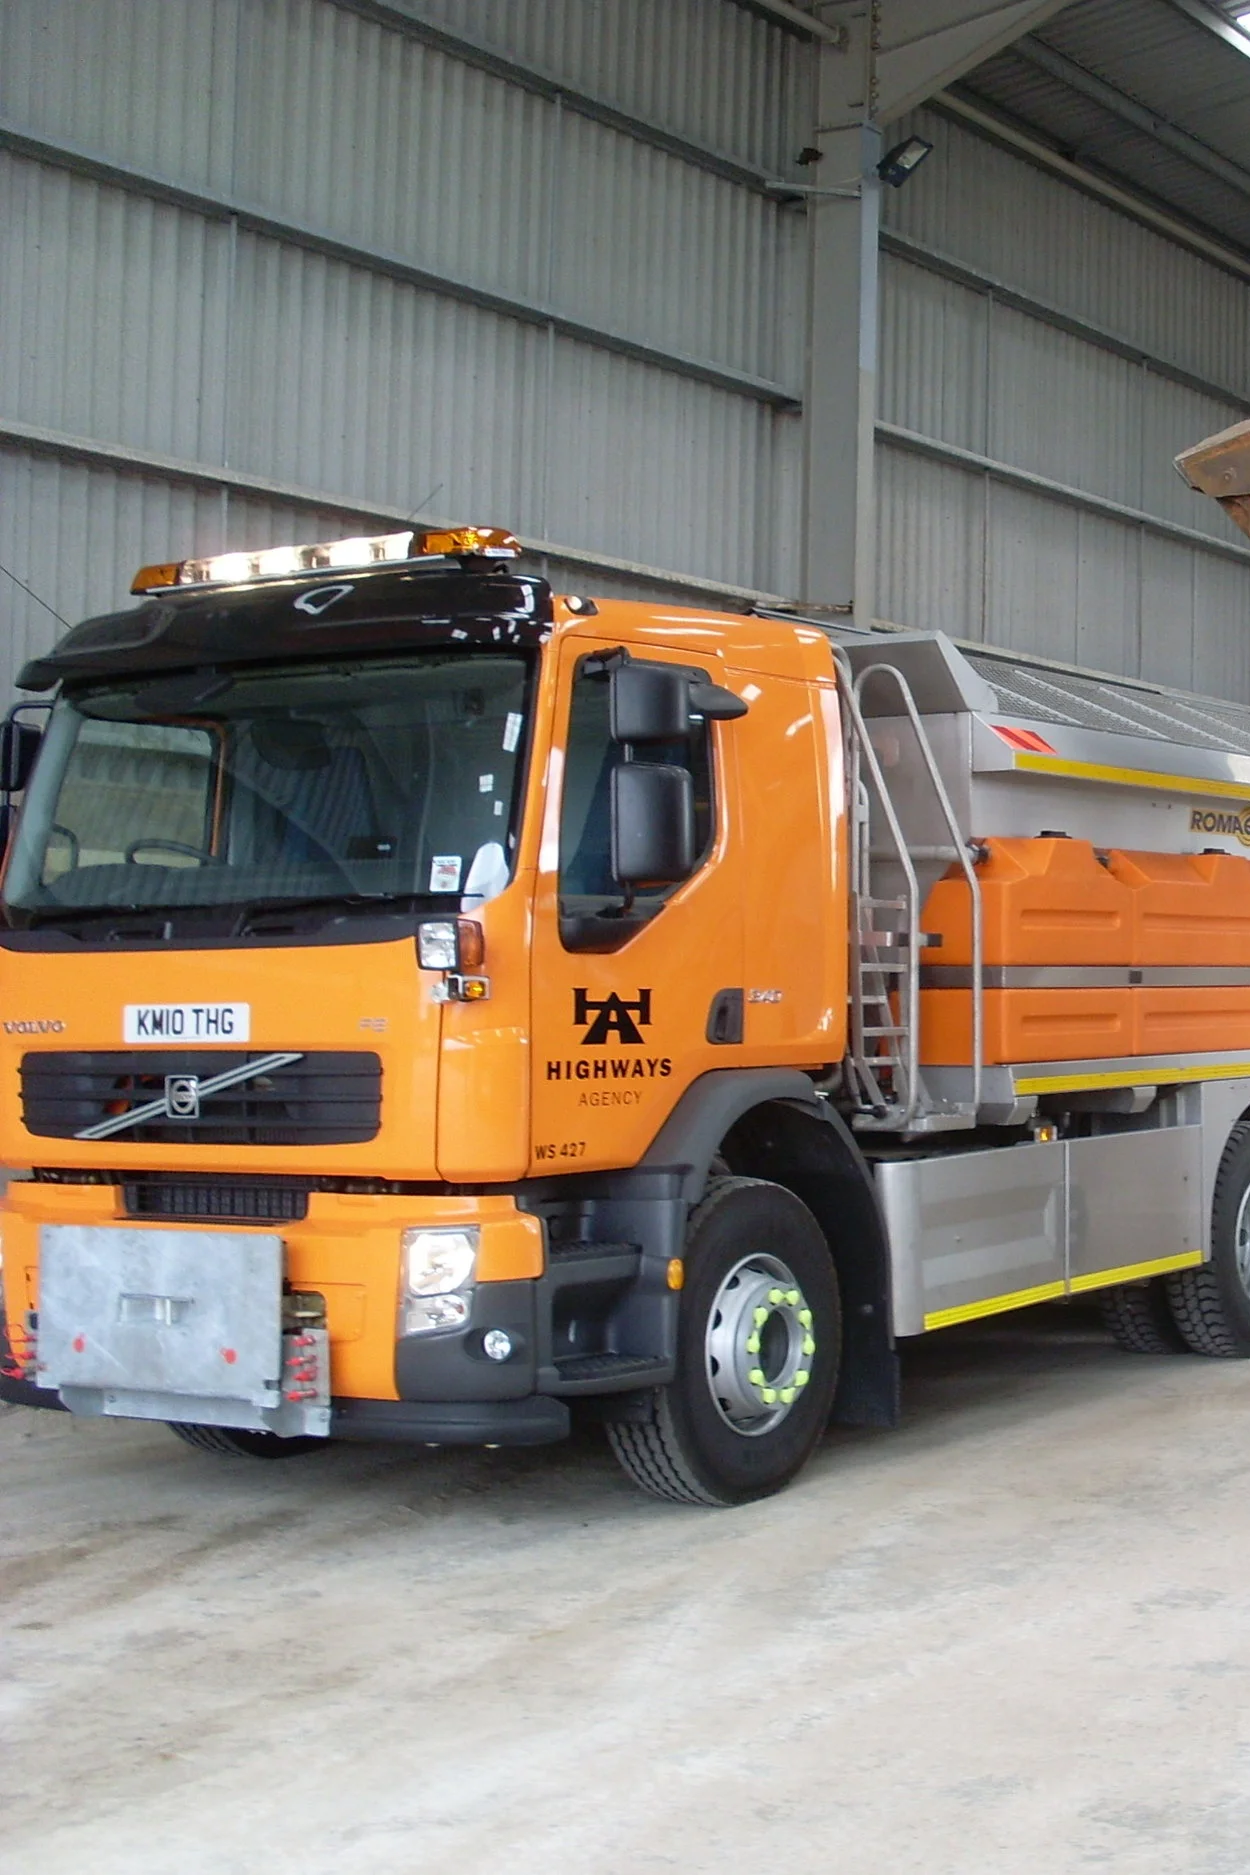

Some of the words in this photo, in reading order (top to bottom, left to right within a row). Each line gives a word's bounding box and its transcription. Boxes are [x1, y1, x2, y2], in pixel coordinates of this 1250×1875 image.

[3, 1020, 65, 1034] VOLVO
[136, 1008, 184, 1036] KM10
[191, 1008, 235, 1035] THG
[546, 1057, 672, 1081] HIGHWAYS
[577, 1090, 643, 1107] AGENCY
[535, 1144, 556, 1160] WS
[560, 1141, 586, 1157] 427
